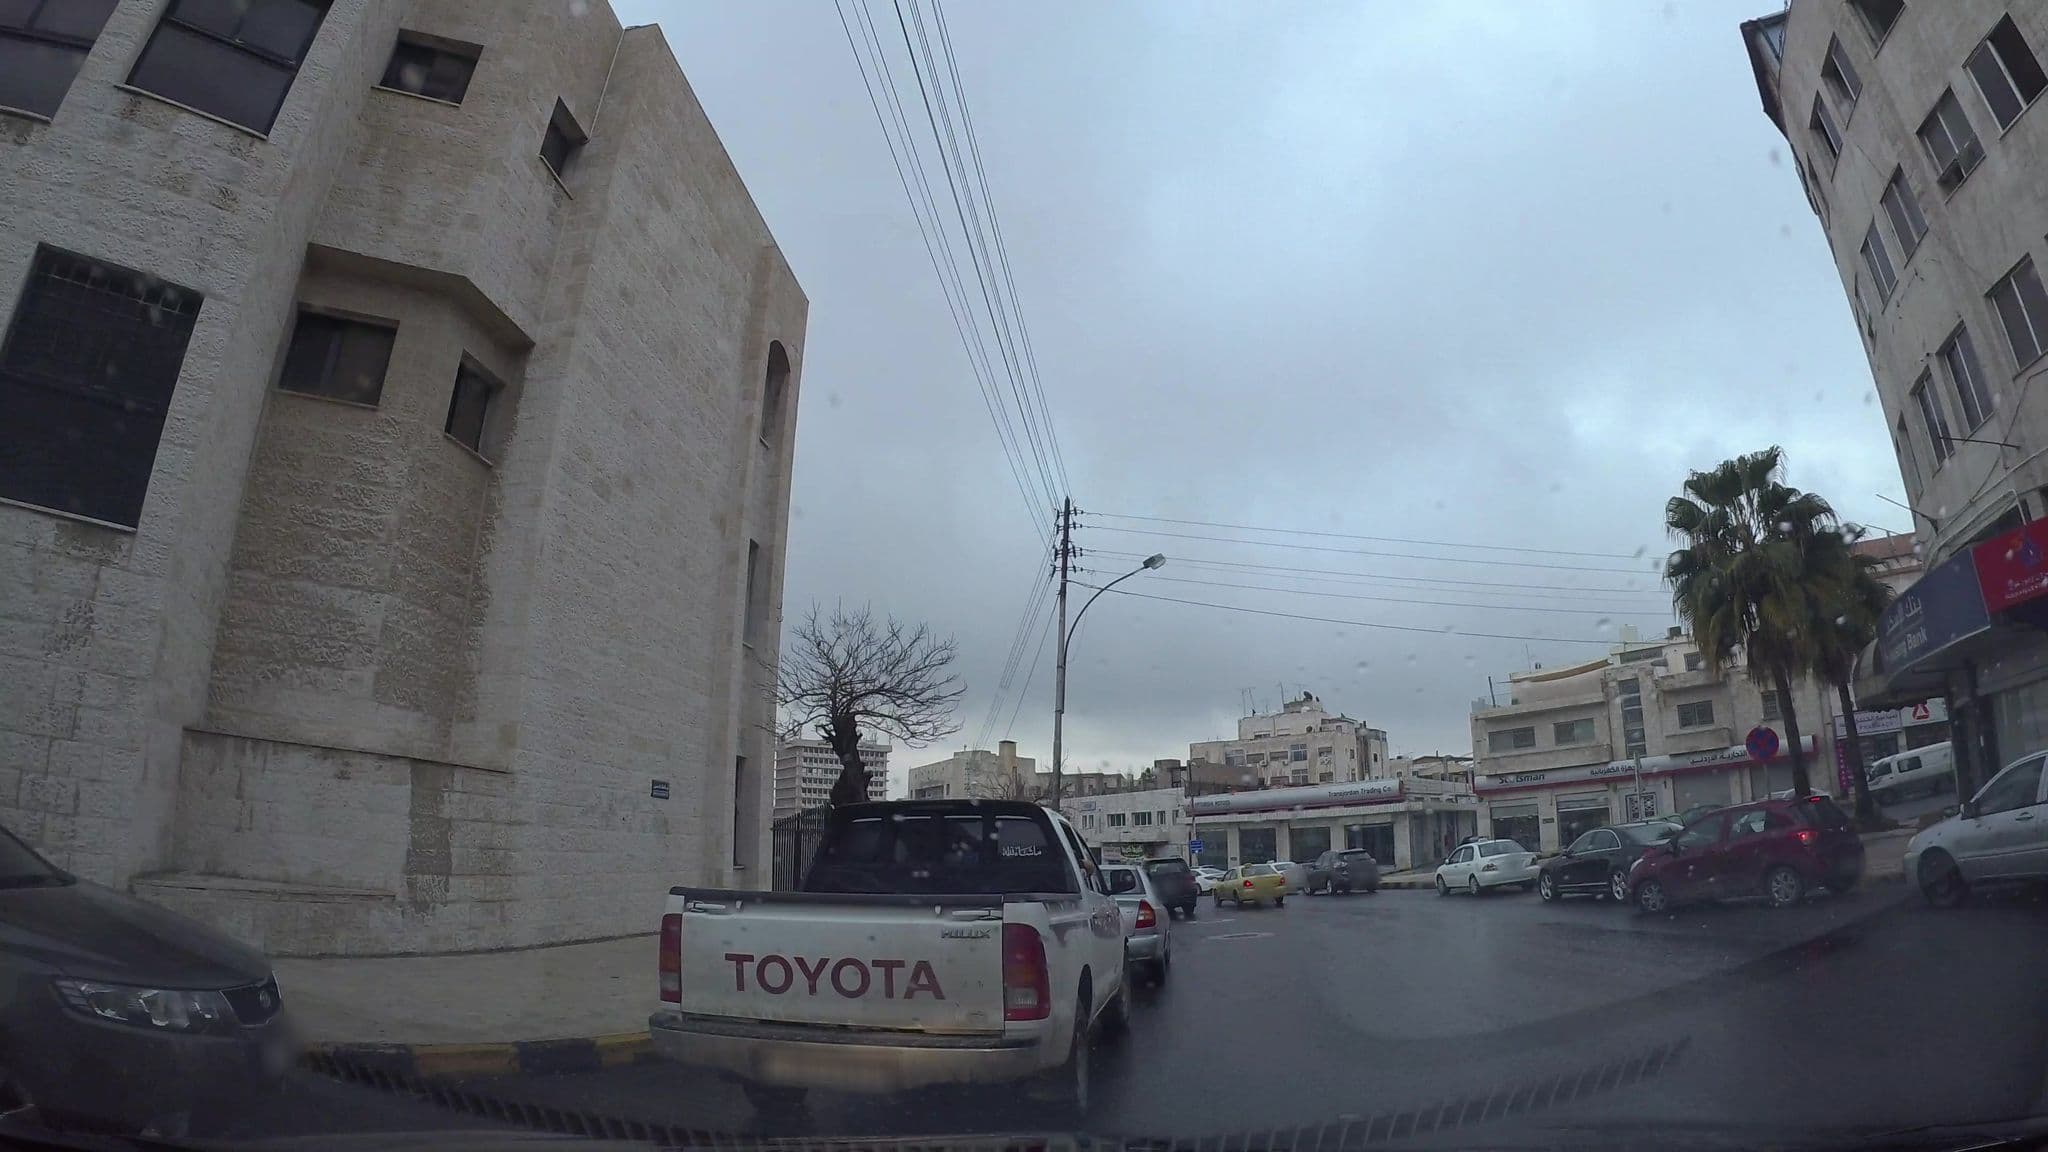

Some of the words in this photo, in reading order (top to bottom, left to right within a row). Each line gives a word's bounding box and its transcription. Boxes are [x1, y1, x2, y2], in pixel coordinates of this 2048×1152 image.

[1907, 626, 1928, 651] Bank
[1360, 786, 1382, 795] Trading
[941, 928, 991, 939] HILUX
[725, 953, 946, 1000] TOYOTA
